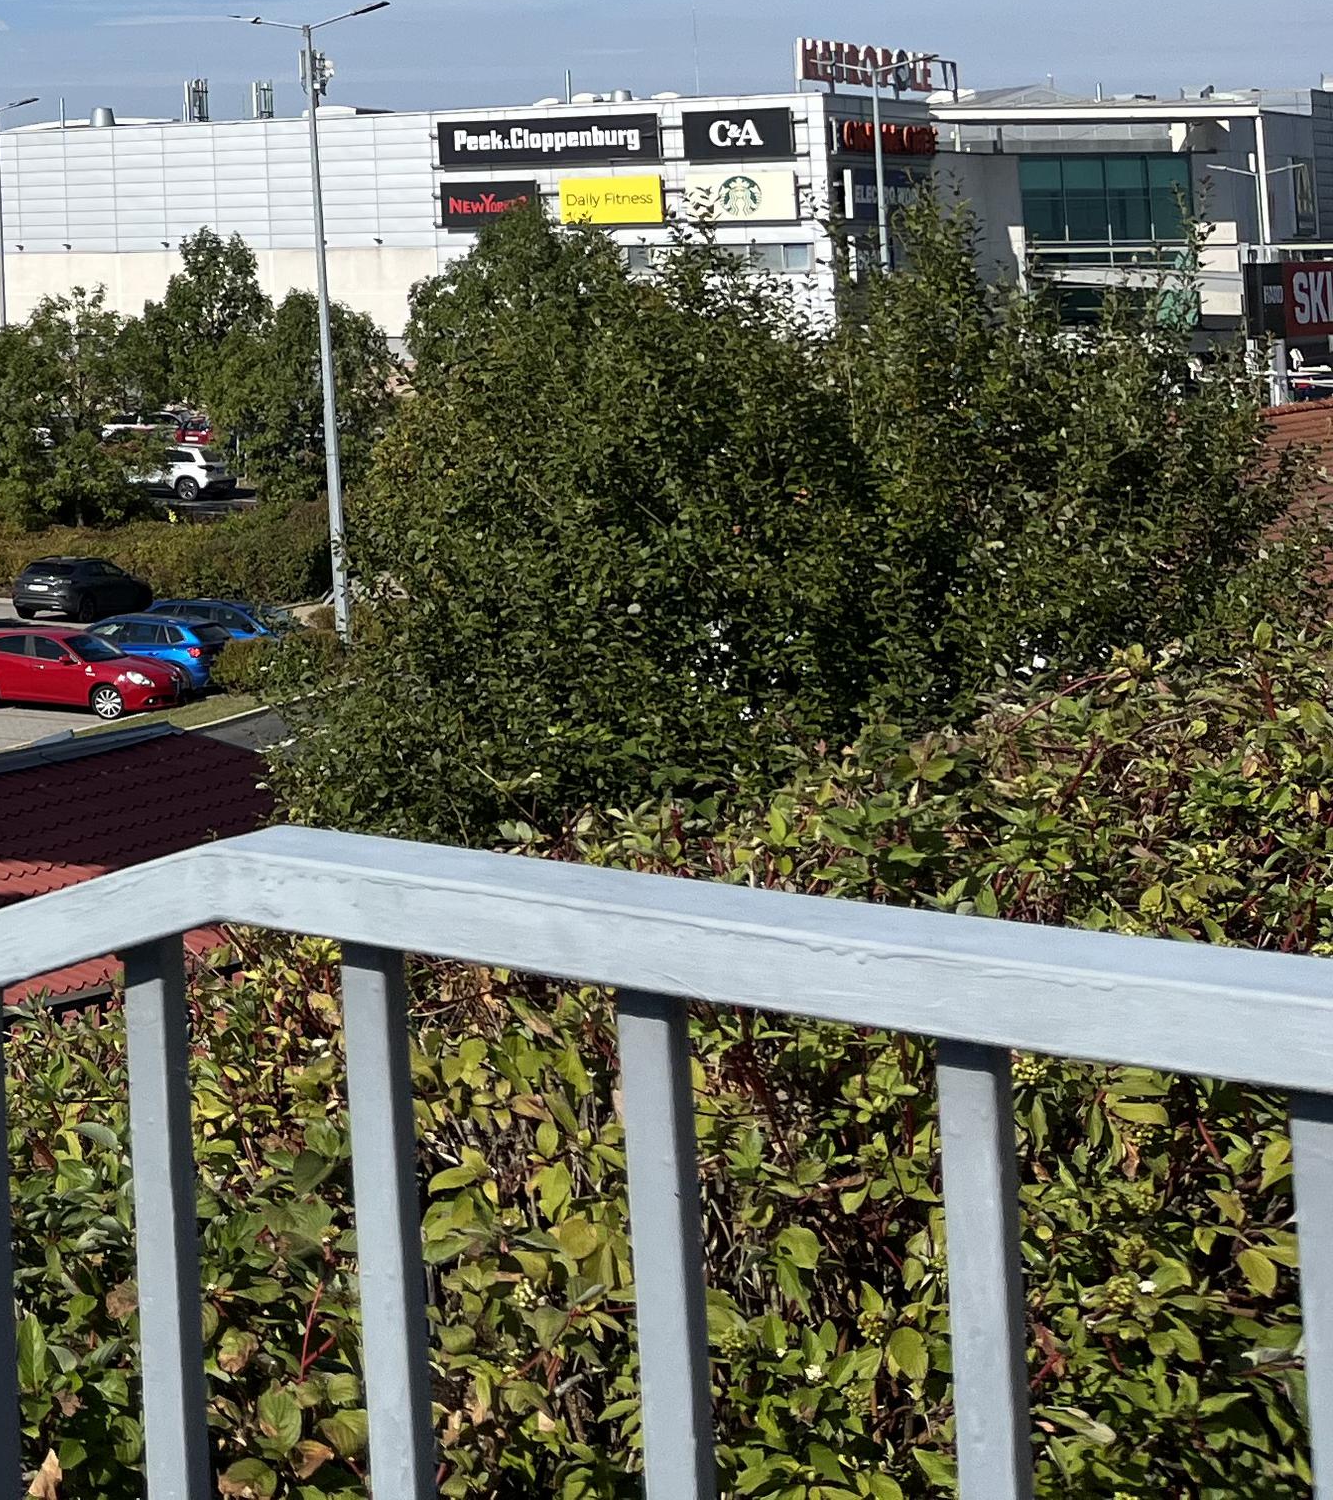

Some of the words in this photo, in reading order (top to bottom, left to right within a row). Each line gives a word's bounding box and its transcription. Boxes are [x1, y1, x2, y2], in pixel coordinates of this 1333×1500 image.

[708, 118, 764, 147] C&A
[565, 192, 601, 209] Daily
[604, 190, 654, 207] Fitness
